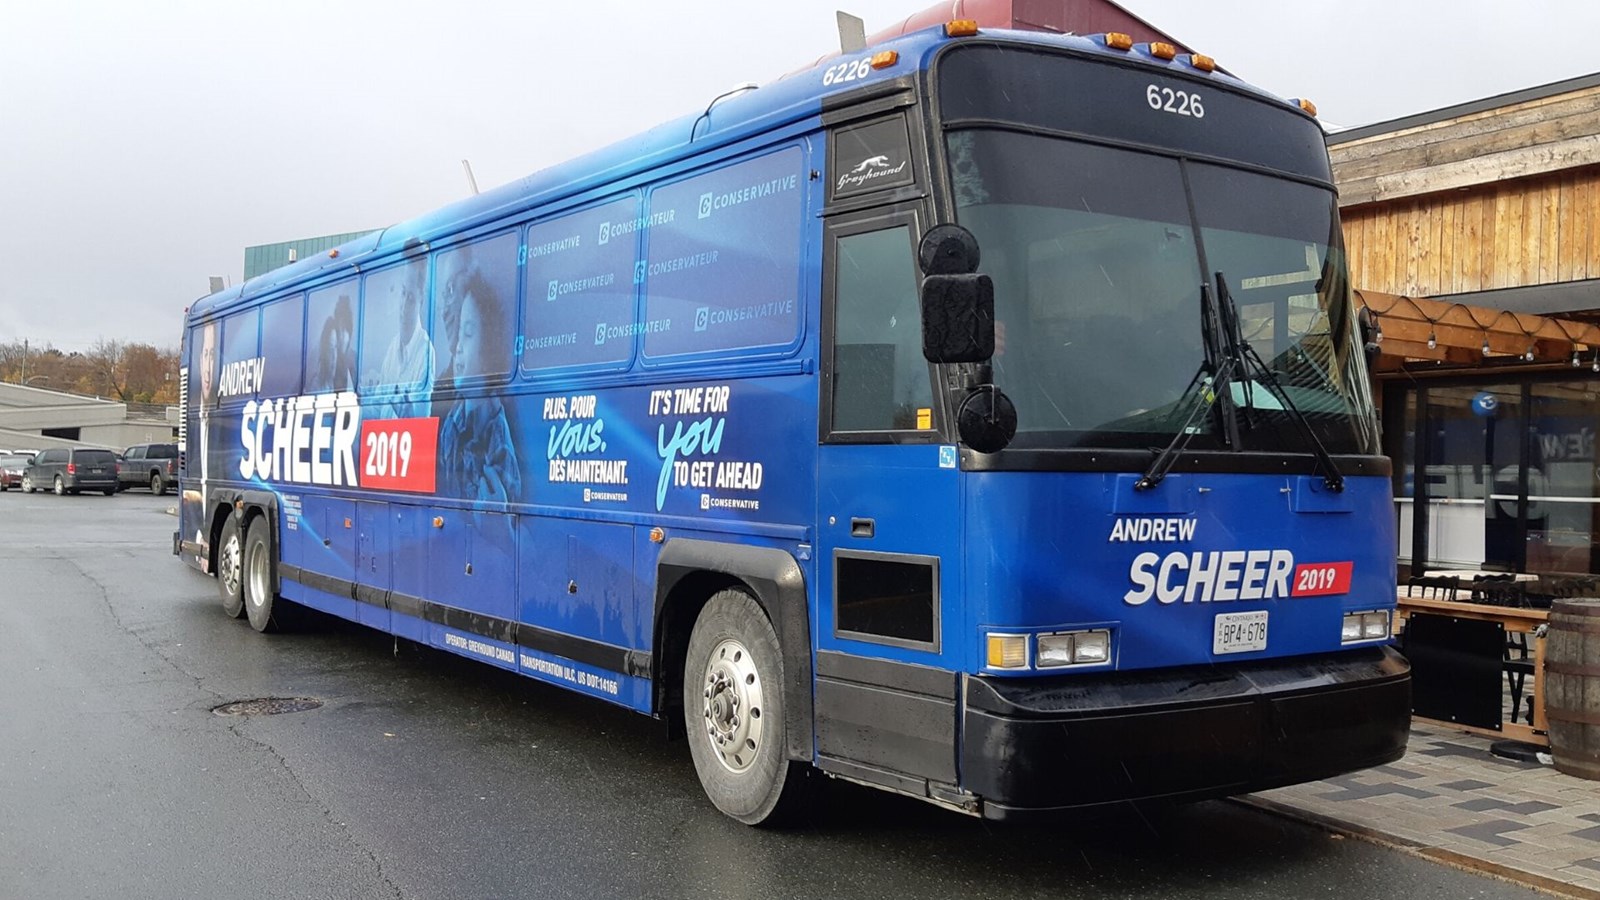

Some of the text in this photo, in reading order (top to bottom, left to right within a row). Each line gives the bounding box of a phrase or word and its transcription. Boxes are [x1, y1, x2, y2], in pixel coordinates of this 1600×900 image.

[823, 57, 871, 86] 6226
[1146, 84, 1204, 118] 6226
[837, 161, 906, 190] Greyhound
[714, 174, 797, 210] CONSERVATIVE
[611, 209, 675, 238] CONSERVATEUR
[528, 235, 580, 259] CONSERVATIVE
[648, 251, 719, 276] CONSERVATEUR
[558, 273, 614, 295] CONSERVATEUR
[710, 300, 793, 325] CONSERVATIVE
[525, 333, 577, 350] CONSERVATIVE
[607, 319, 671, 339] CONSERVATEUR
[218, 357, 265, 397] ANDREW
[543, 395, 597, 420] PLUS. POUR
[649, 386, 729, 416] IT'S TIME FOR
[239, 391, 360, 487] SCHEER
[365, 431, 412, 478] 2019
[656, 417, 725, 511] you
[567, 461, 628, 484] MAINTENANT.
[674, 461, 762, 490] TO GET AHEAD
[591, 492, 627, 501] CONSERVATEUR
[710, 499, 759, 510] CONSERVATIVE
[1109, 518, 1197, 542] ANDREW
[1123, 549, 1336, 605] SCHEER 2019
[468, 641, 495, 658] GREYHOUND
[496, 648, 515, 664] CANADA
[520, 654, 563, 678] TRANSPORTATION
[577, 672, 587, 685] US
